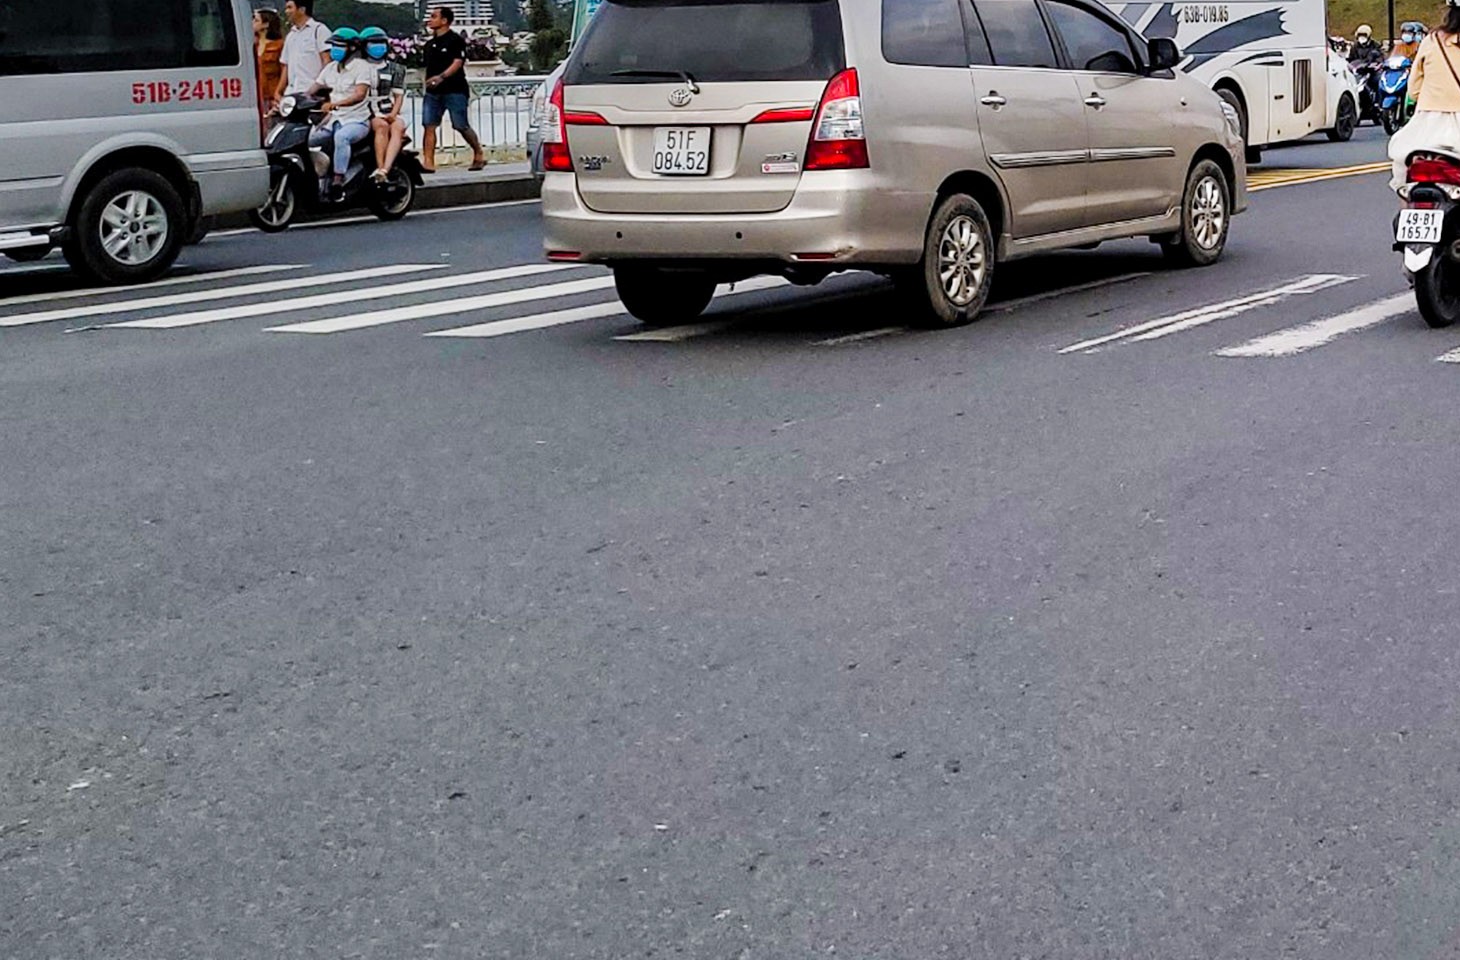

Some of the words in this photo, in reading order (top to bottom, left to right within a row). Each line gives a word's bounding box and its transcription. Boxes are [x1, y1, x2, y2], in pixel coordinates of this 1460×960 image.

[667, 130, 696, 149] 51F
[655, 151, 706, 170] 084.52
[1401, 227, 1438, 240] 165.71
